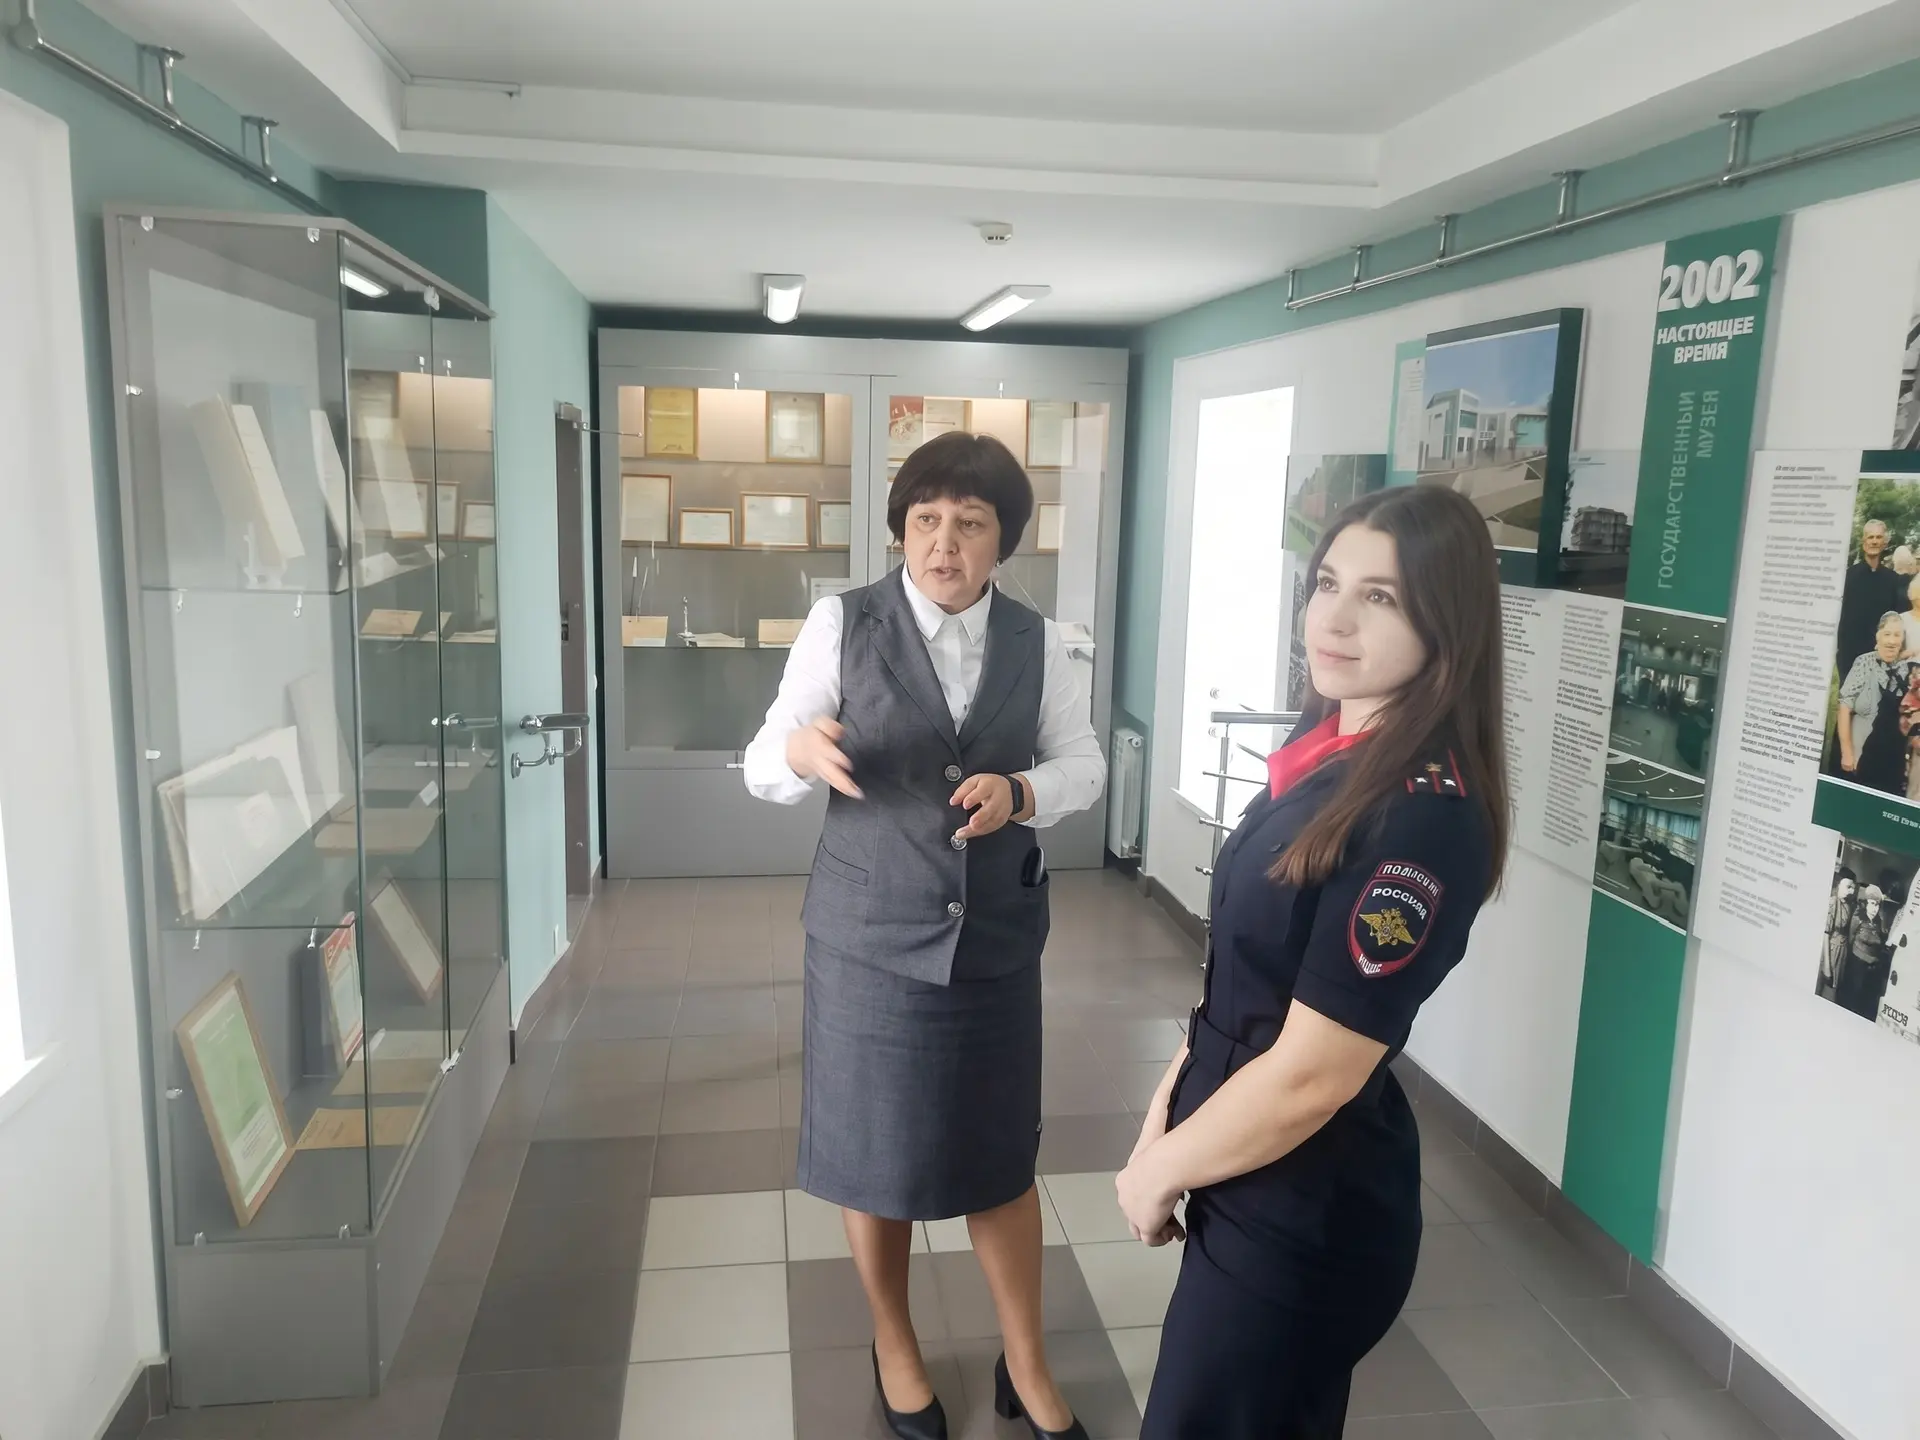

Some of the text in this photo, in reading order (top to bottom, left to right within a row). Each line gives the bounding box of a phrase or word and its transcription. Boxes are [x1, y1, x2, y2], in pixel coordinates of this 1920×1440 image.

[1657, 249, 1764, 313] 2002
[1656, 315, 1755, 345] НАСТОЯЩЕЕ
[1673, 341, 1729, 365] ВРЕМЯ
